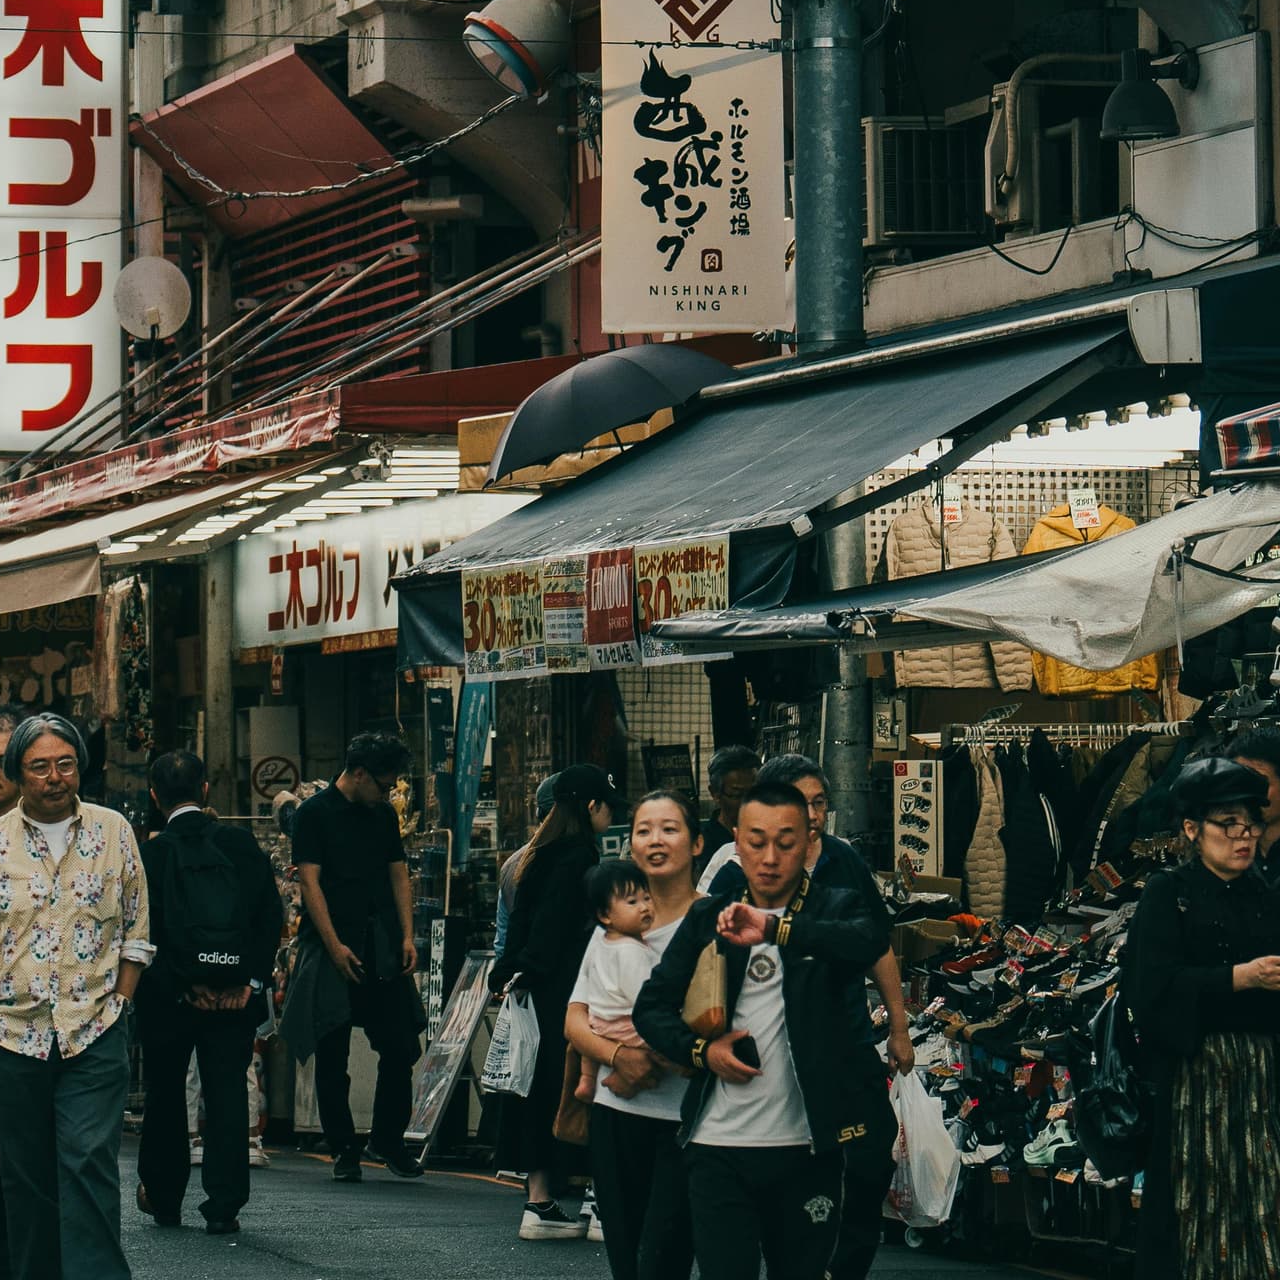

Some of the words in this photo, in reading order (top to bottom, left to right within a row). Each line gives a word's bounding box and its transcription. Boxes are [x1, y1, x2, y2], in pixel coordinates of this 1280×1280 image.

[633, 46, 724, 272] 西成キング
[728, 97, 752, 236] ホルモン酒場
[649, 284, 749, 297] NISHINARI
[676, 300, 721, 312] KING
[268, 540, 361, 632] 二木ゴルフ
[590, 563, 630, 612] LONDON
[596, 643, 634, 665] マルセル店
[198, 951, 240, 965] adidas
